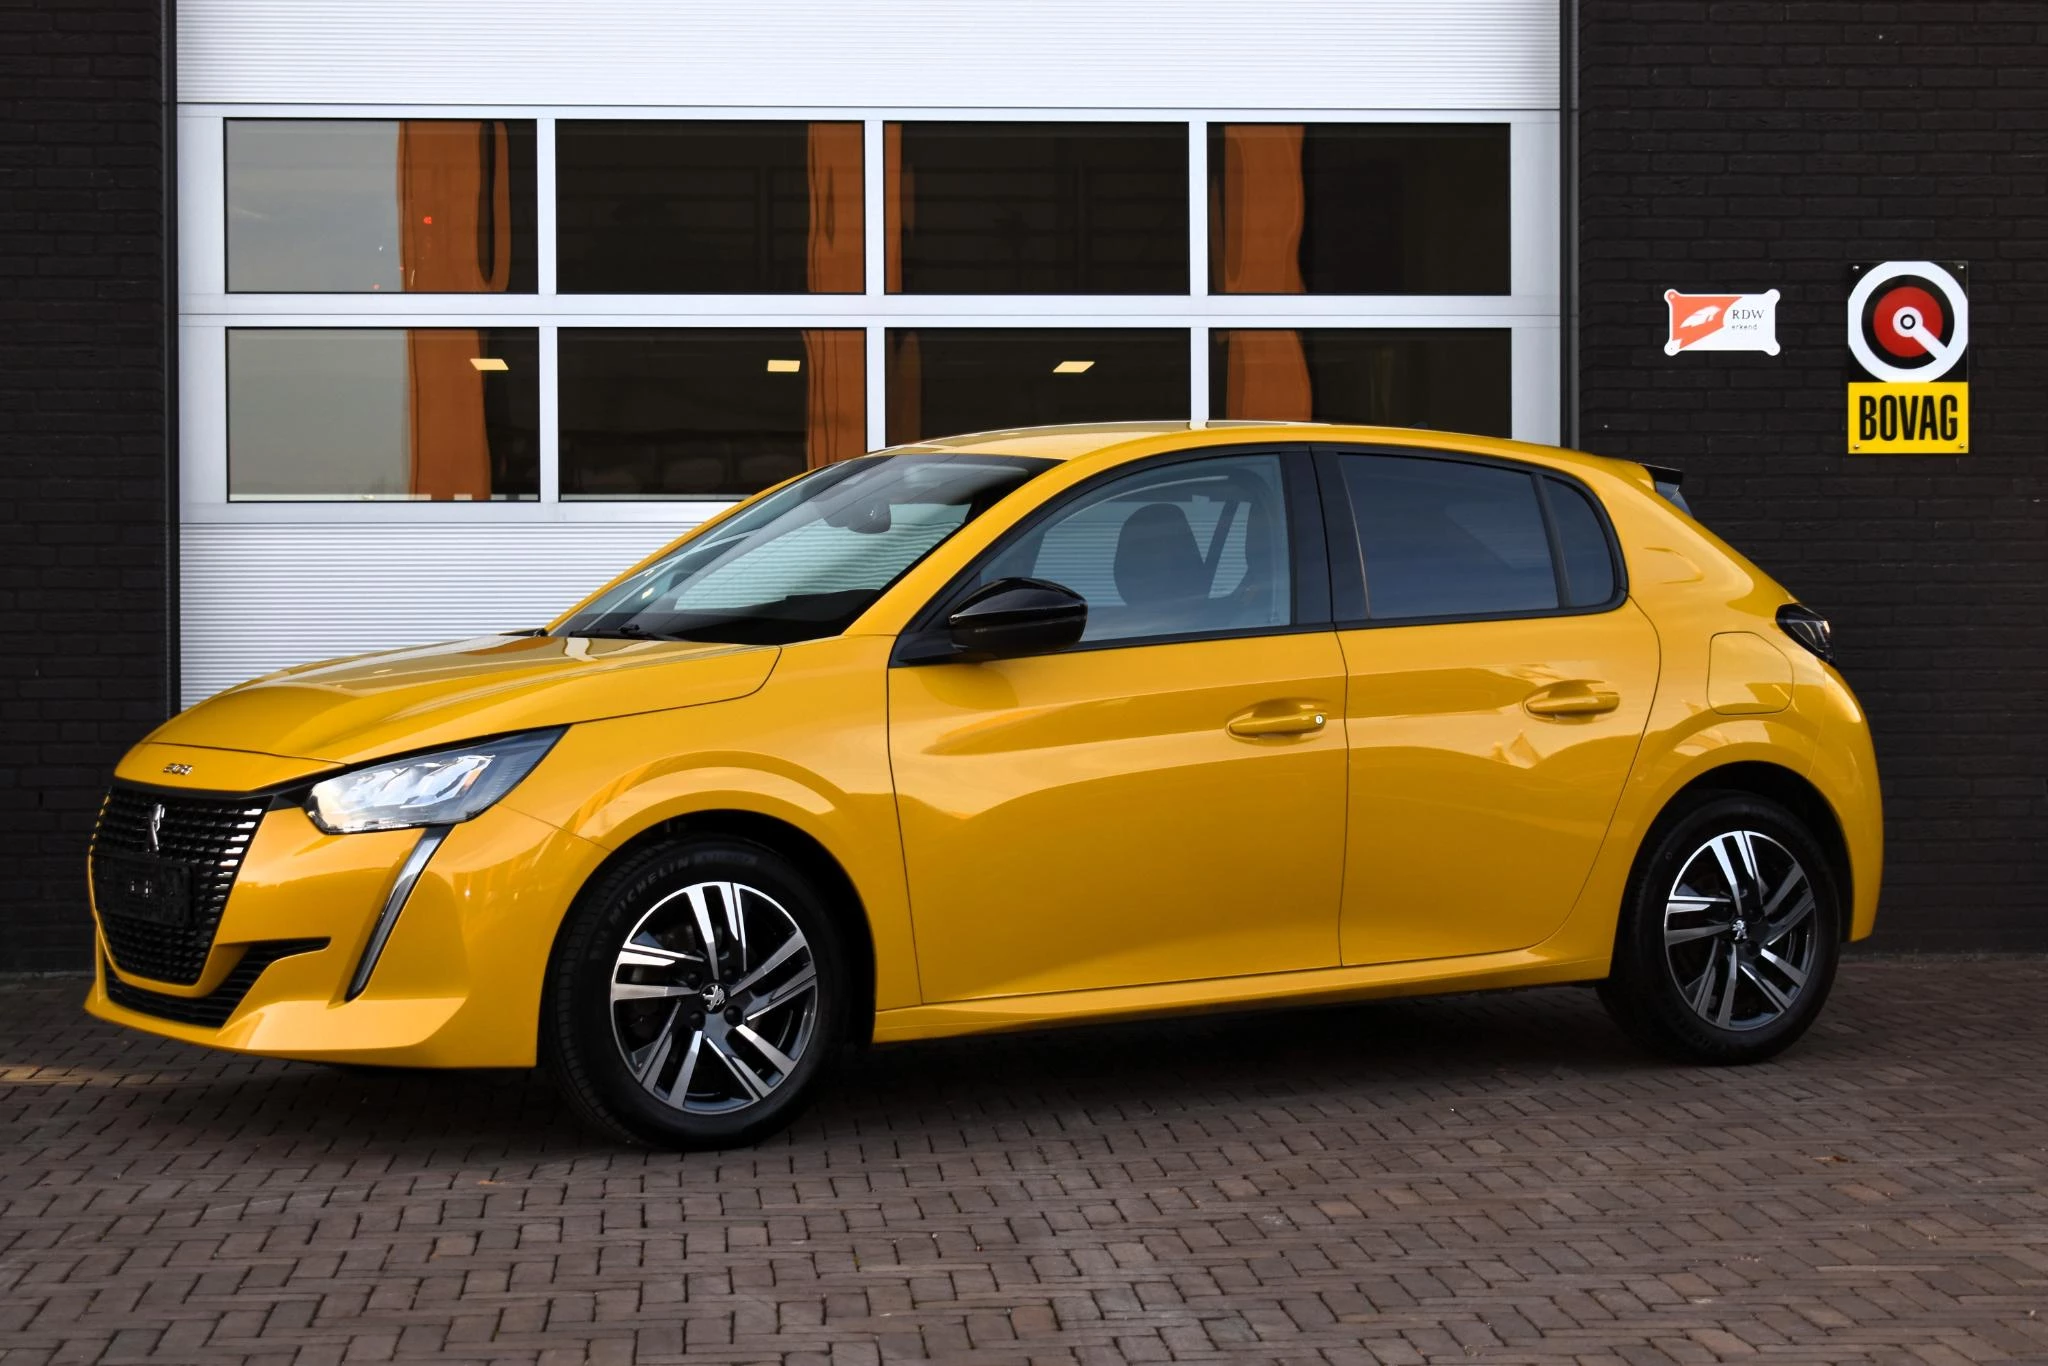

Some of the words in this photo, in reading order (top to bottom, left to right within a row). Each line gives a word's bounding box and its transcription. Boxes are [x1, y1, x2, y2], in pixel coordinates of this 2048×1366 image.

[1731, 309, 1765, 320] RDW
[1859, 394, 1958, 441] BOVAG
[608, 856, 689, 925] MICHELIN
